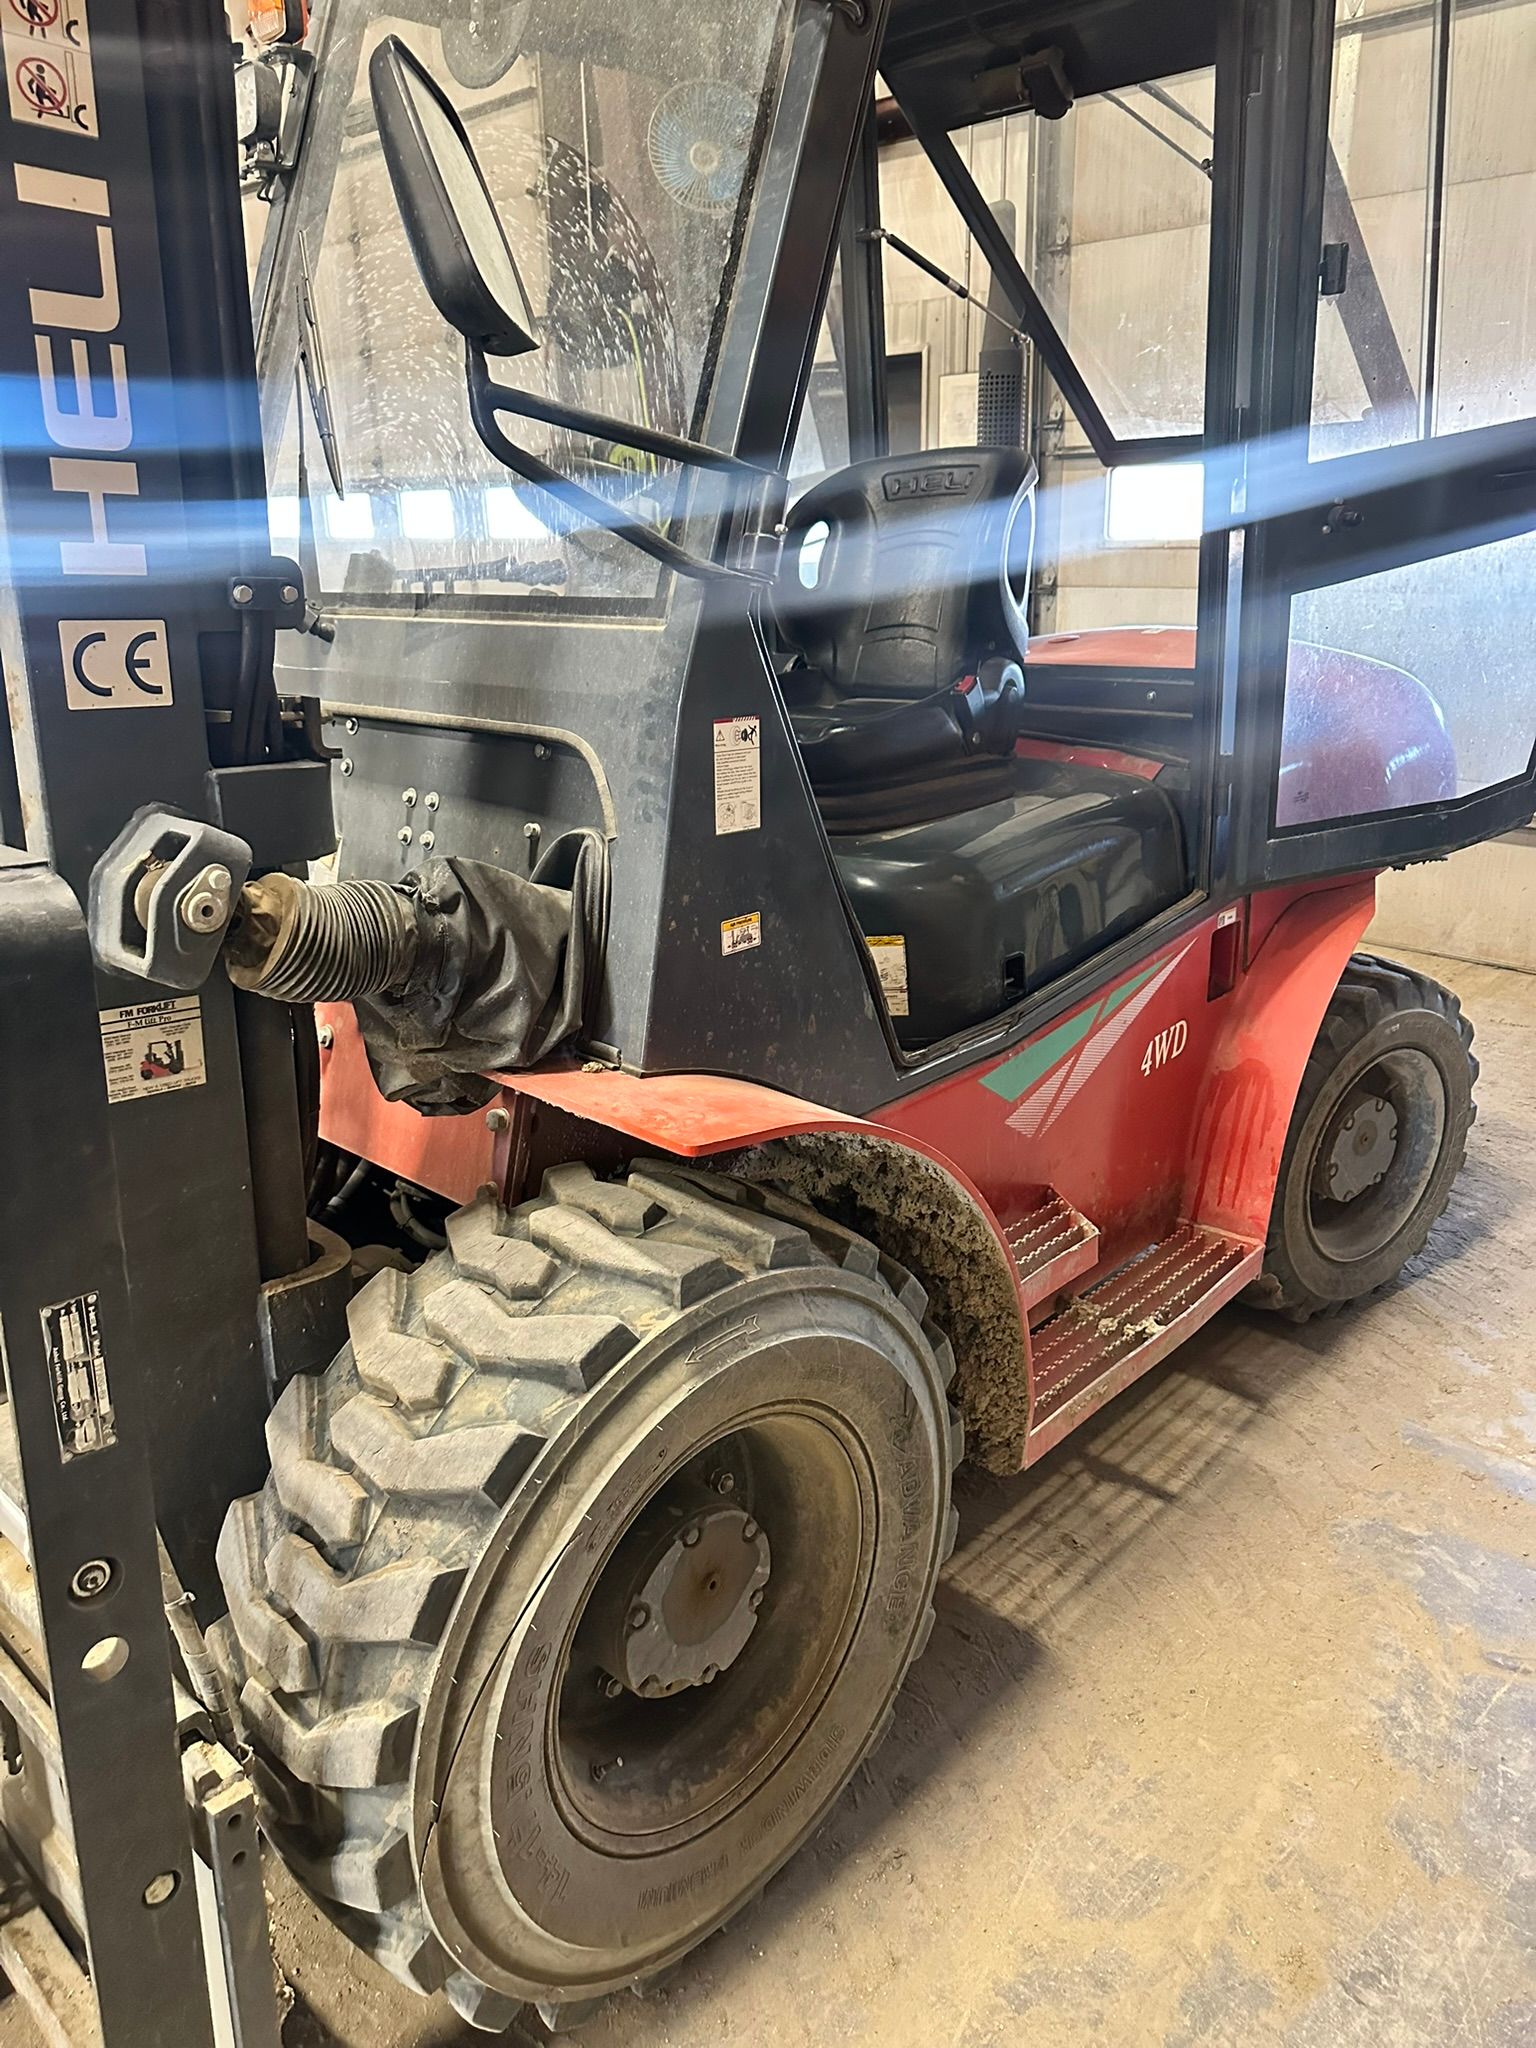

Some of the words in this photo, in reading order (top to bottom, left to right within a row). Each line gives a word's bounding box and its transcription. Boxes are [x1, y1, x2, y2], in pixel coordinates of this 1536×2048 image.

[13, 162, 148, 577] HELI
[888, 470, 975, 497] HELI
[73, 630, 165, 697] CE
[119, 1009, 135, 1019] FM
[136, 1001, 177, 1015] FORKLIFT
[158, 1014, 172, 1023] Pro
[1139, 1018, 1189, 1077] 4WD
[87, 1306, 98, 1335] HELI
[887, 1457, 921, 1613] ADVANCE
